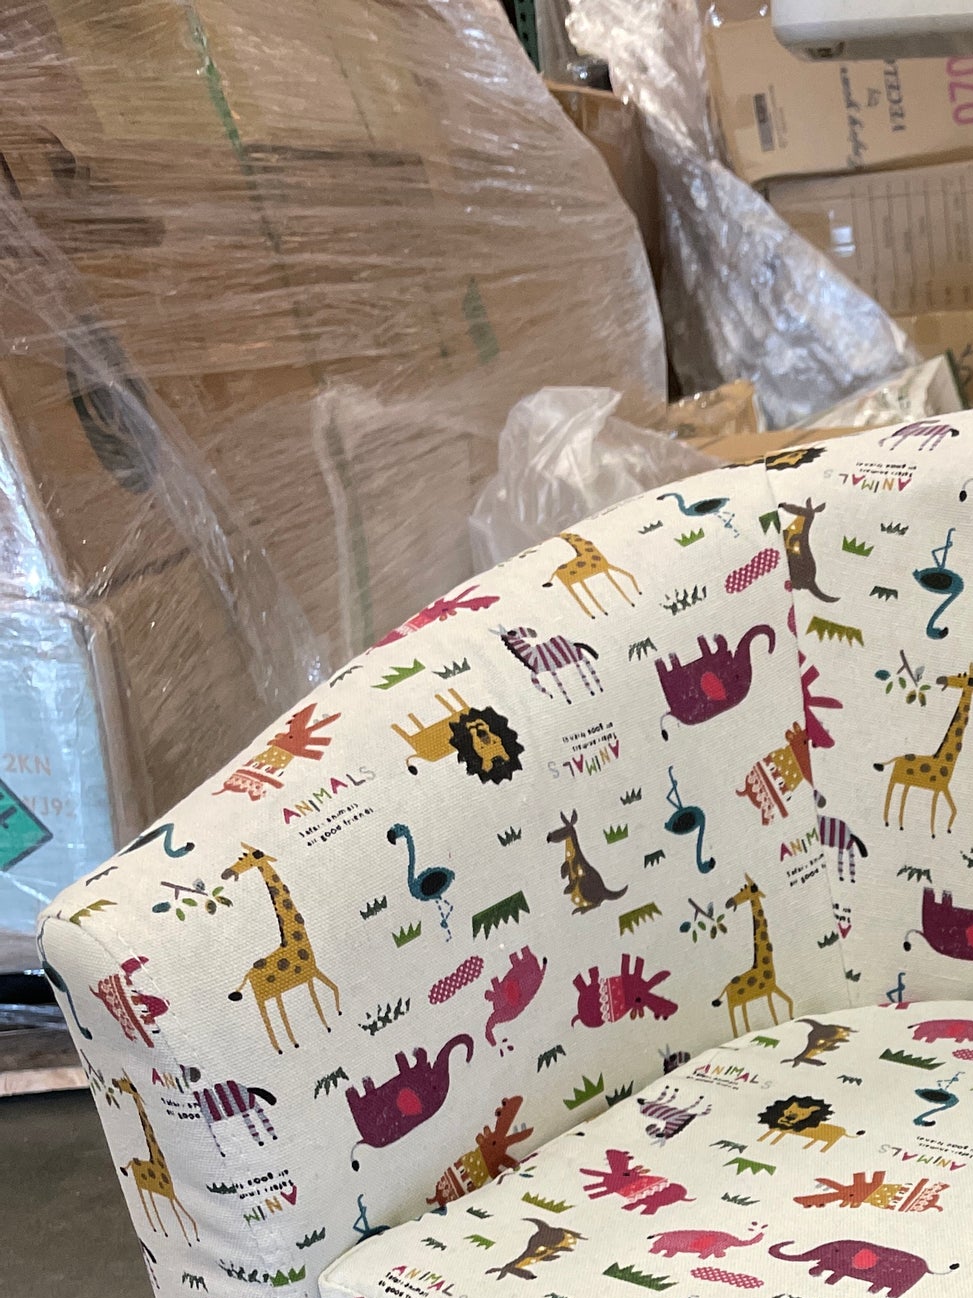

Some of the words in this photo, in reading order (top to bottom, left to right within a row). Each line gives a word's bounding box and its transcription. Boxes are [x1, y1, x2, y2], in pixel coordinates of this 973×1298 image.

[823, 468, 912, 492] ANIMALS
[547, 739, 620, 779] ANIMALS
[283, 765, 376, 825] ANIMALS
[696, 1064, 773, 1089] ANIMALS
[879, 1144, 966, 1171] ANIMALS
